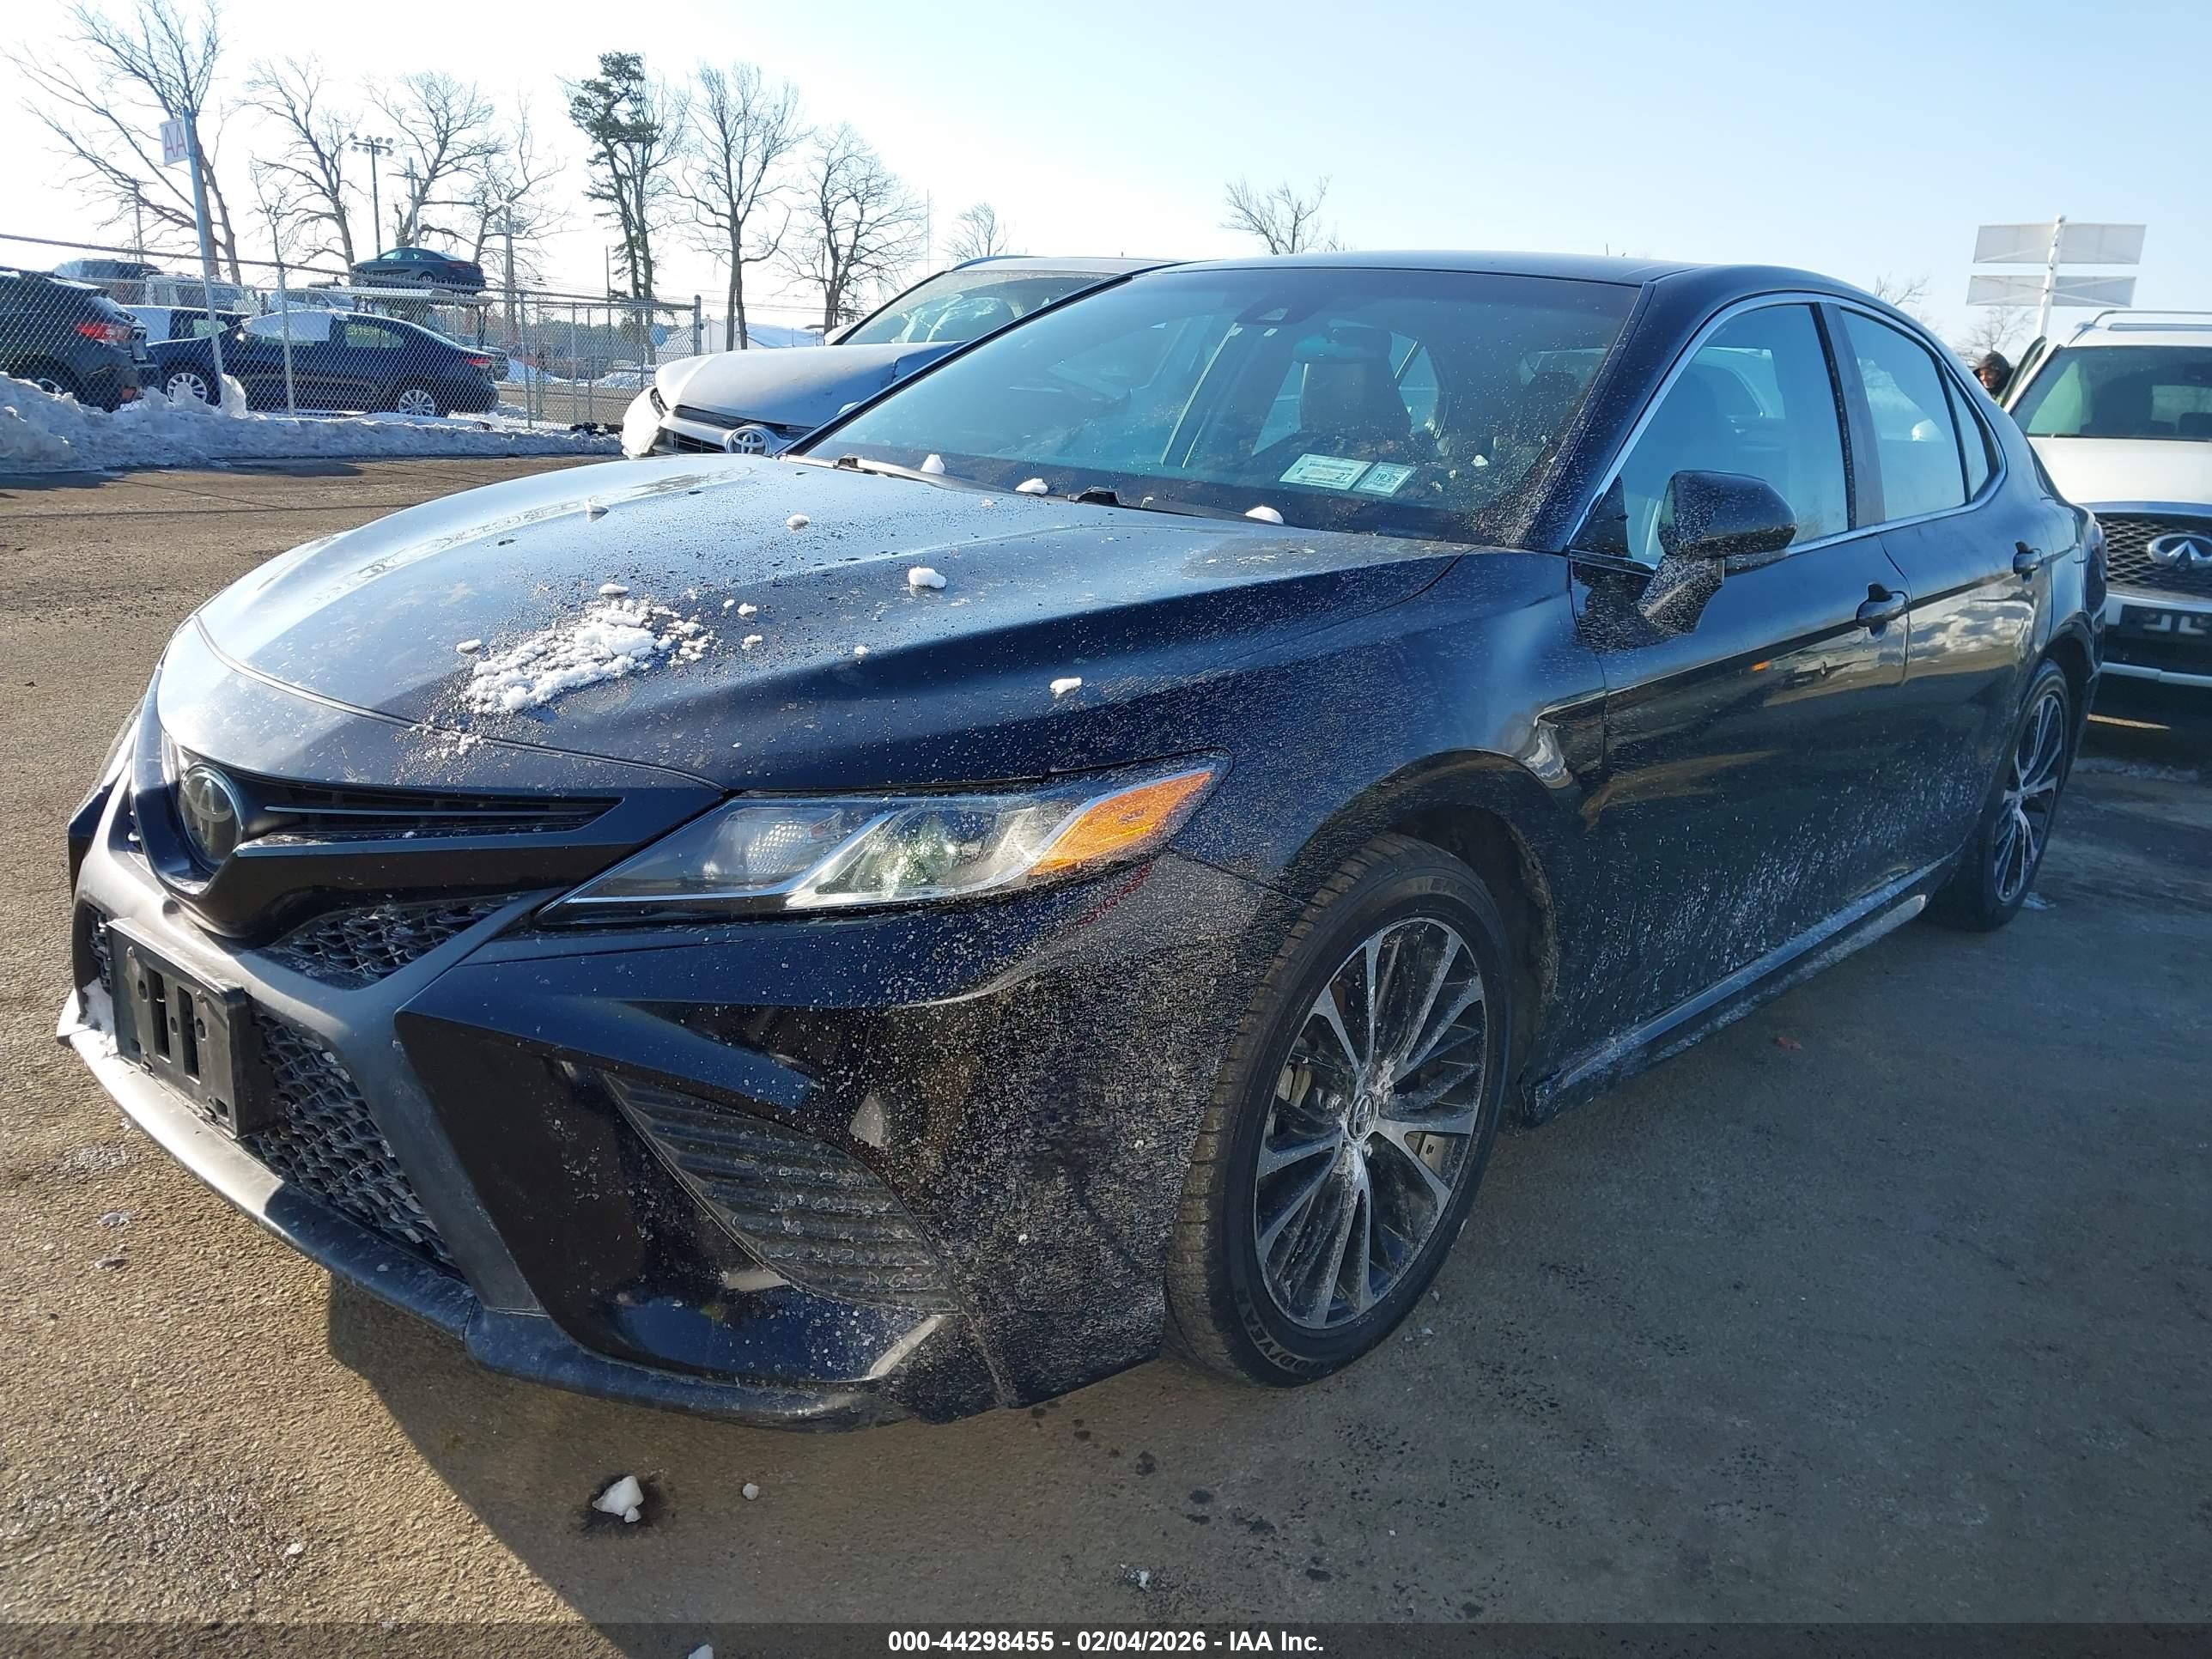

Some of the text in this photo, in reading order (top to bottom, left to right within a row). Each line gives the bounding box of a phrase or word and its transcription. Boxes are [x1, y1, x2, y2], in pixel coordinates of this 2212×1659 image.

[164, 123, 188, 158] AA
[1335, 472, 1353, 481] 27
[1376, 472, 1388, 481] 10
